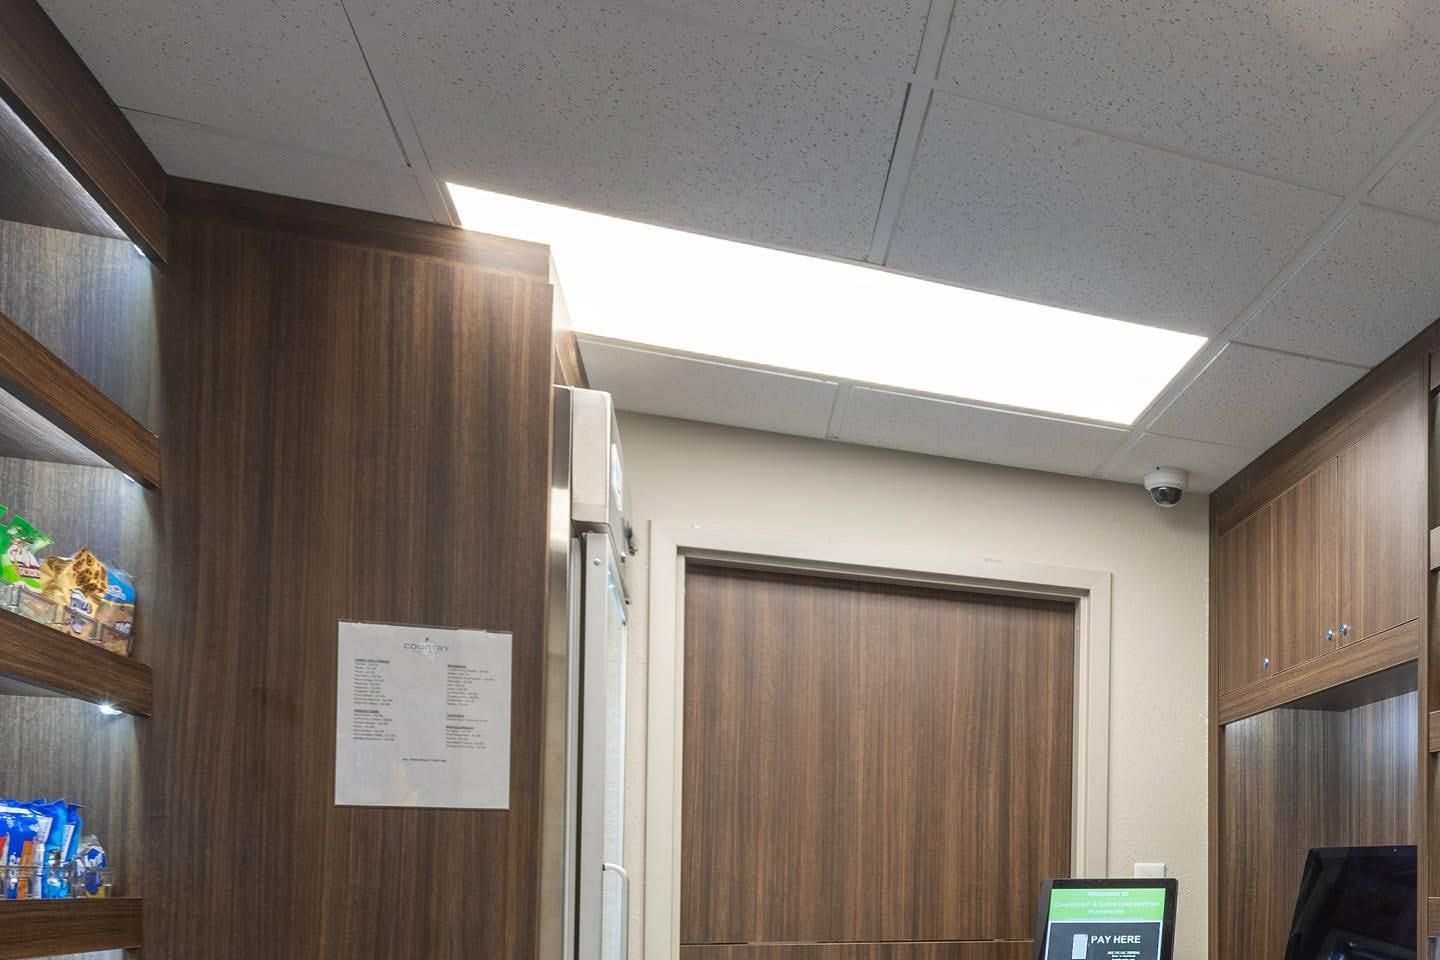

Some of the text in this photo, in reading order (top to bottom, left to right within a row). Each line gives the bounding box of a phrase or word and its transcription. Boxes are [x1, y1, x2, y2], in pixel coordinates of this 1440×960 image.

[403, 642, 450, 652] COUNTRY
[1090, 935, 1142, 944] PAY HERE
